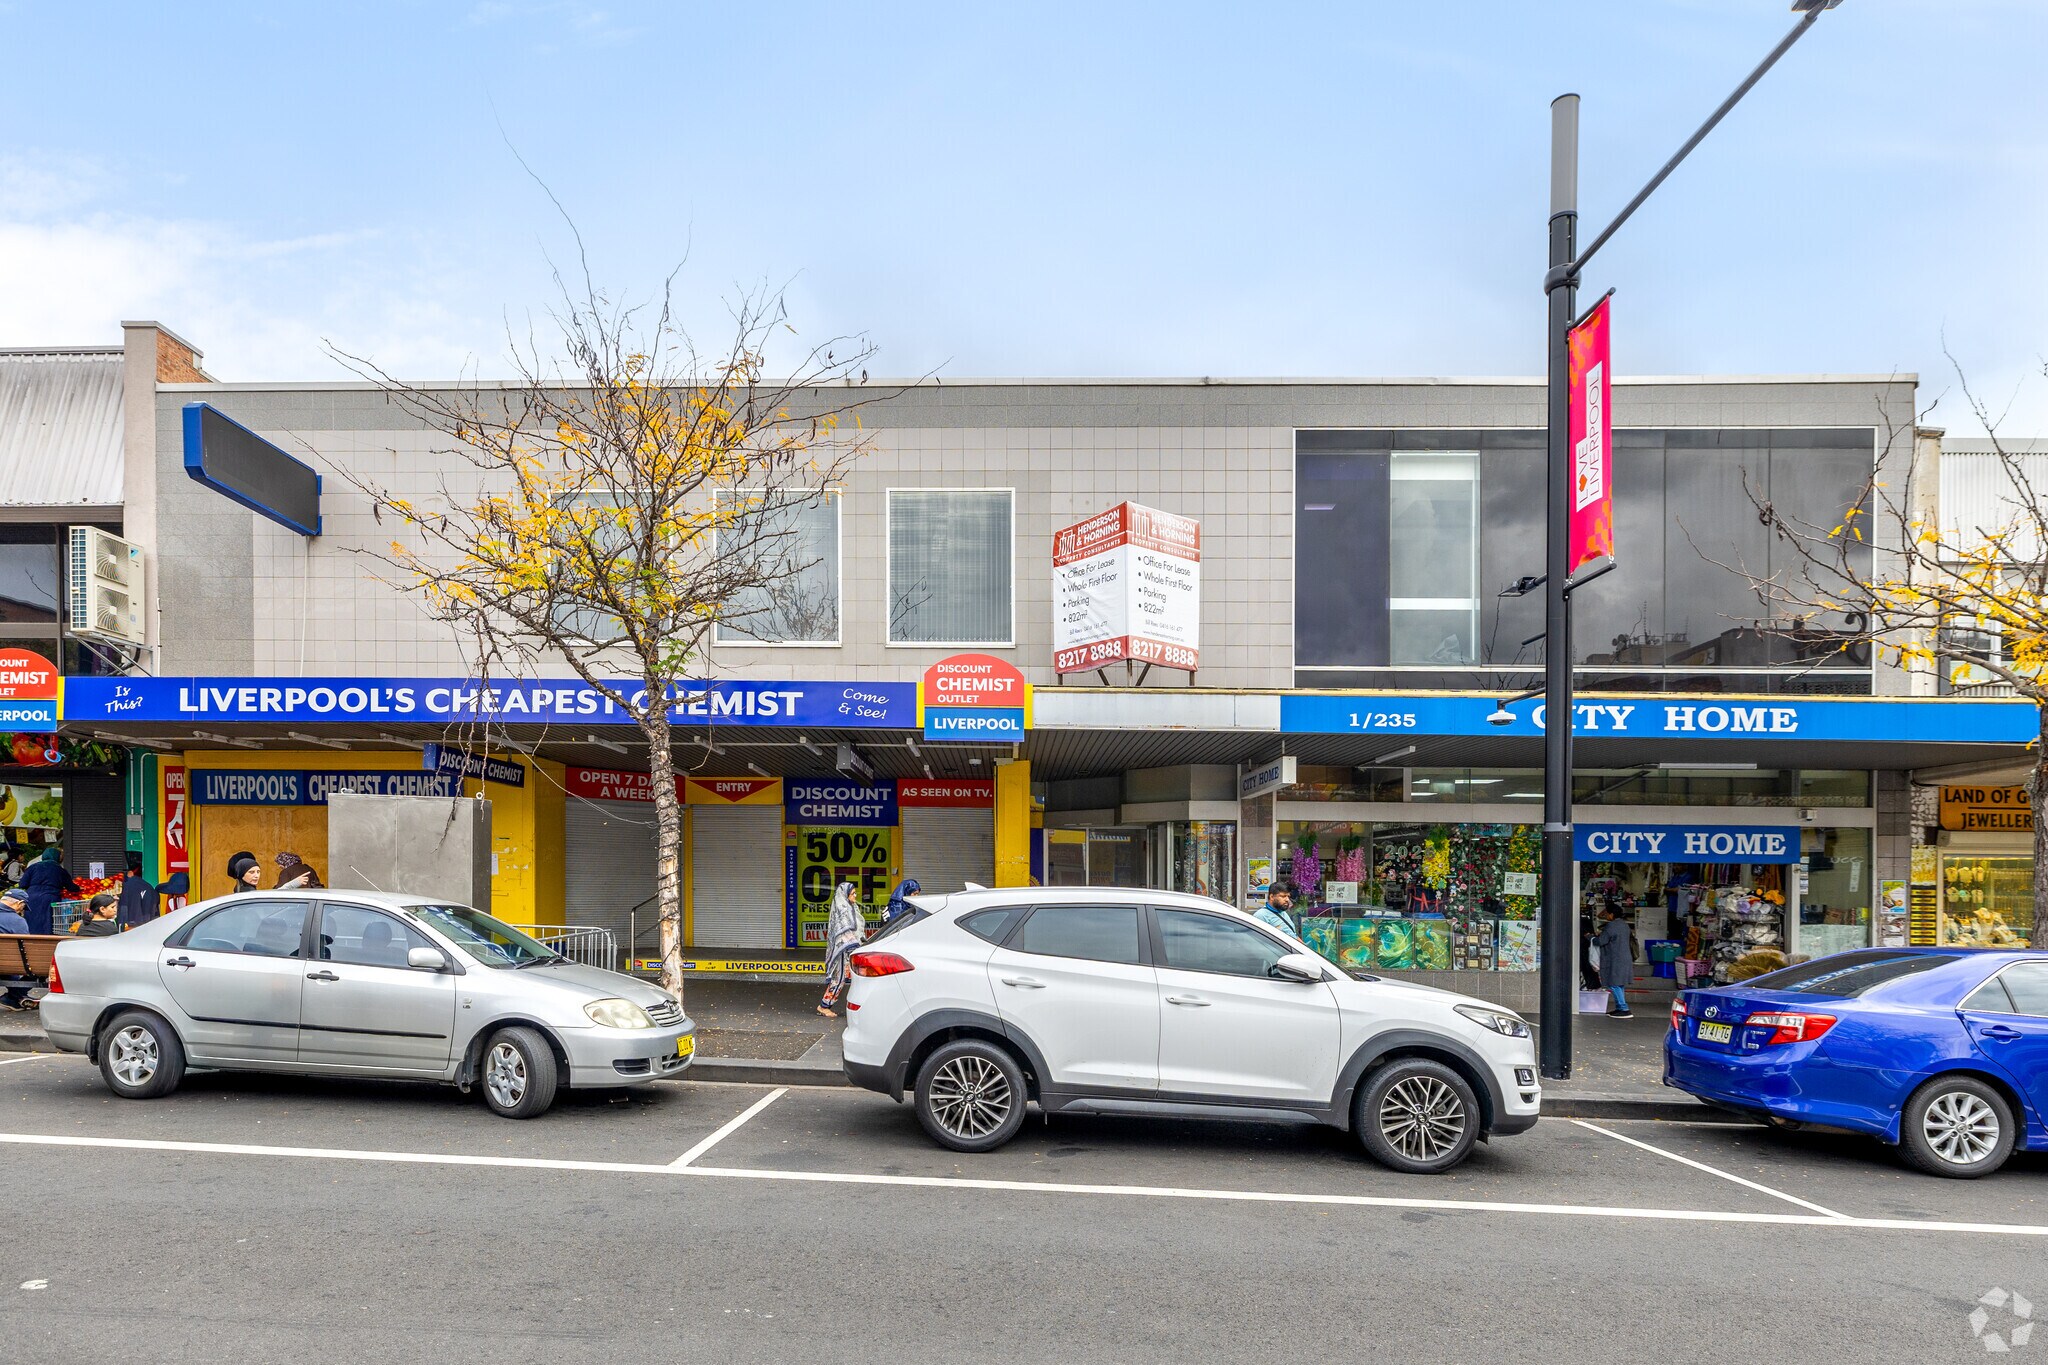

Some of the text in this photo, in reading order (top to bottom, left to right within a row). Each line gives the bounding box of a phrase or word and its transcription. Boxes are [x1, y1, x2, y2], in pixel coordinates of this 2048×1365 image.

[1589, 369, 1600, 497] LIVERPOOL
[1077, 508, 1120, 536] HENDERSON
[1151, 512, 1196, 535] HENDERSON
[1076, 521, 1120, 547] & HORNING
[1151, 524, 1195, 545] & HORNING
[1067, 558, 1115, 579] Office For Lease
[1143, 555, 1191, 577] Office For Lease
[1067, 572, 1118, 592] Whole First Floor
[1143, 570, 1193, 592] Whole First Floor
[1067, 595, 1090, 609] Parking
[1143, 586, 1167, 604] Parking
[1058, 640, 1122, 669] 8217 8888
[1132, 638, 1196, 667] 8217 8888
[0, 659, 29, 668] OUNT
[937, 664, 992, 674] DISCOUNT
[0, 671, 50, 685] EMIST
[936, 677, 1015, 692] CHEMIST
[0, 687, 16, 696] LET
[114, 685, 131, 698] Is
[842, 687, 890, 705] Come
[937, 694, 980, 704] OUTLET
[104, 696, 144, 714] This?
[425, 688, 623, 715] CHEAPEST
[631, 690, 804, 716] CHEMIST
[838, 703, 887, 719] & See!
[1531, 704, 1799, 733] CTY HOME
[933, 717, 1020, 731] LIVERPOOL
[1349, 712, 1417, 728] 1/235
[166, 772, 186, 789] OPEN
[487, 763, 523, 783] CHEMIST
[579, 770, 655, 787] OPEN 7 DA
[1242, 766, 1280, 792] CITY HOME
[308, 774, 382, 801] CHEAPEST
[387, 775, 451, 797] CHEMIST
[600, 786, 611, 797] A
[715, 782, 752, 793] ENTRY
[792, 786, 892, 801] DISCOUNT
[902, 787, 917, 798] AS
[920, 788, 951, 798] SEEN
[953, 788, 971, 798] ON
[1944, 788, 1985, 804] LAND
[1990, 789, 2011, 804] OF
[799, 804, 884, 818] CHEMIST
[1961, 813, 2034, 830] JEWELLER
[806, 831, 888, 864] 50%
[1587, 831, 1787, 856] CITY HOME
[801, 864, 887, 904] OFF
[805, 930, 822, 941] ALL
[725, 962, 793, 971] LIVERPOOL'S
[795, 963, 825, 972] CHEA
